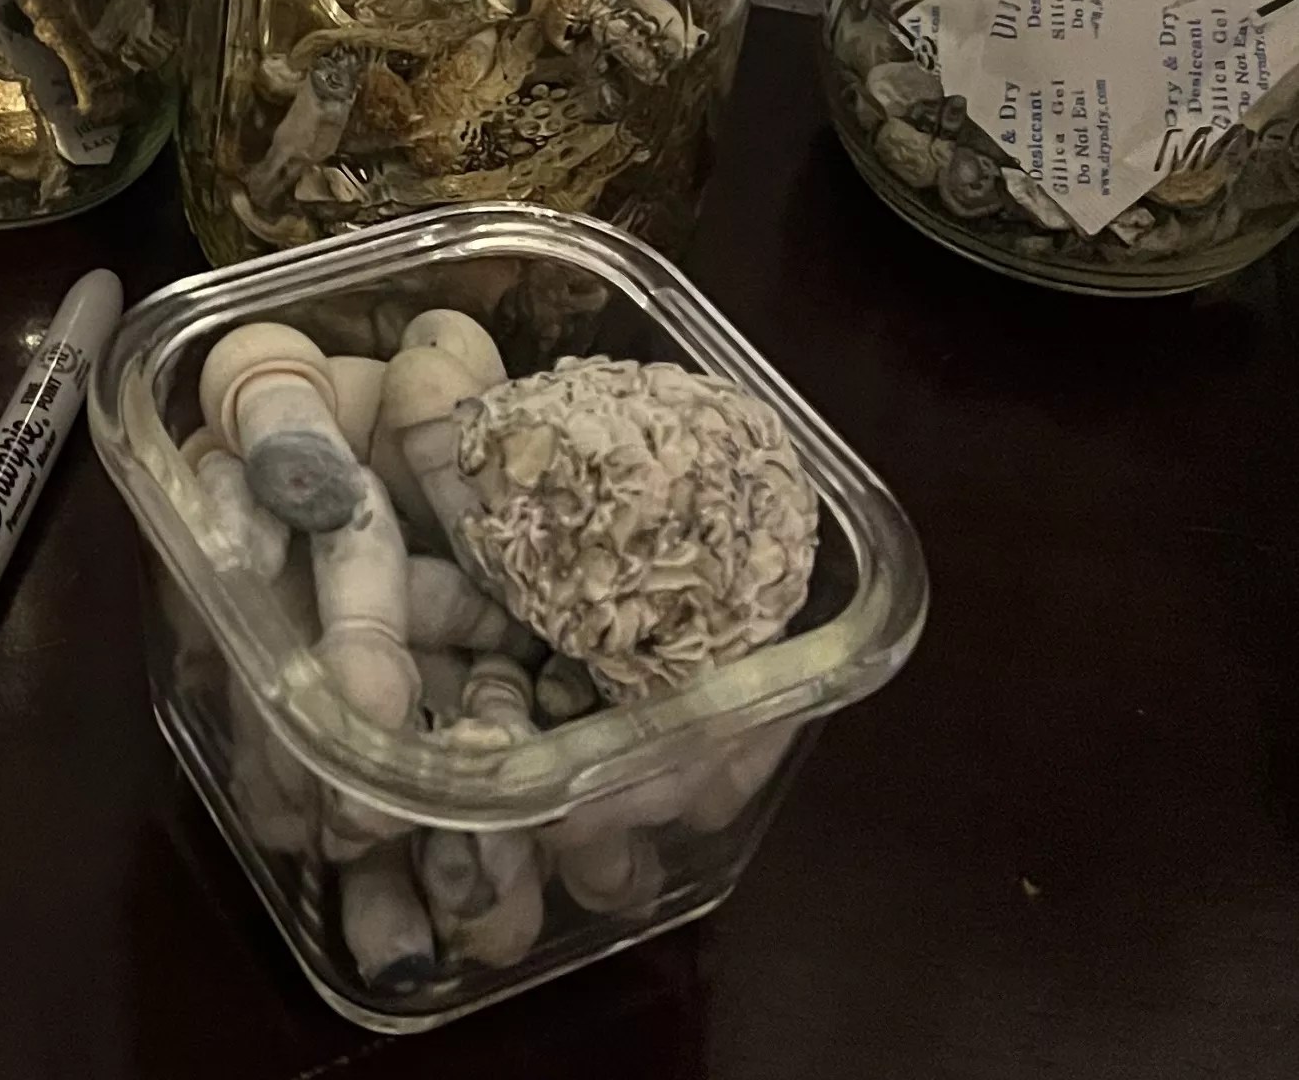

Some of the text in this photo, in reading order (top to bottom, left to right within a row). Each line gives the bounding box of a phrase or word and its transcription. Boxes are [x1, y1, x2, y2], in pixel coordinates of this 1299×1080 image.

[1071, 10, 1084, 29] Do
[1159, 8, 1179, 46] Dry
[1186, 20, 1203, 113] Desiccant
[1234, 53, 1250, 84] Not
[1000, 80, 1021, 120] Dry
[1051, 80, 1065, 115] Gel
[1027, 88, 1043, 181] Desiccant
[1073, 126, 1090, 158] Not
[1077, 163, 1091, 185] Do
[36, 374, 62, 412] POINT
